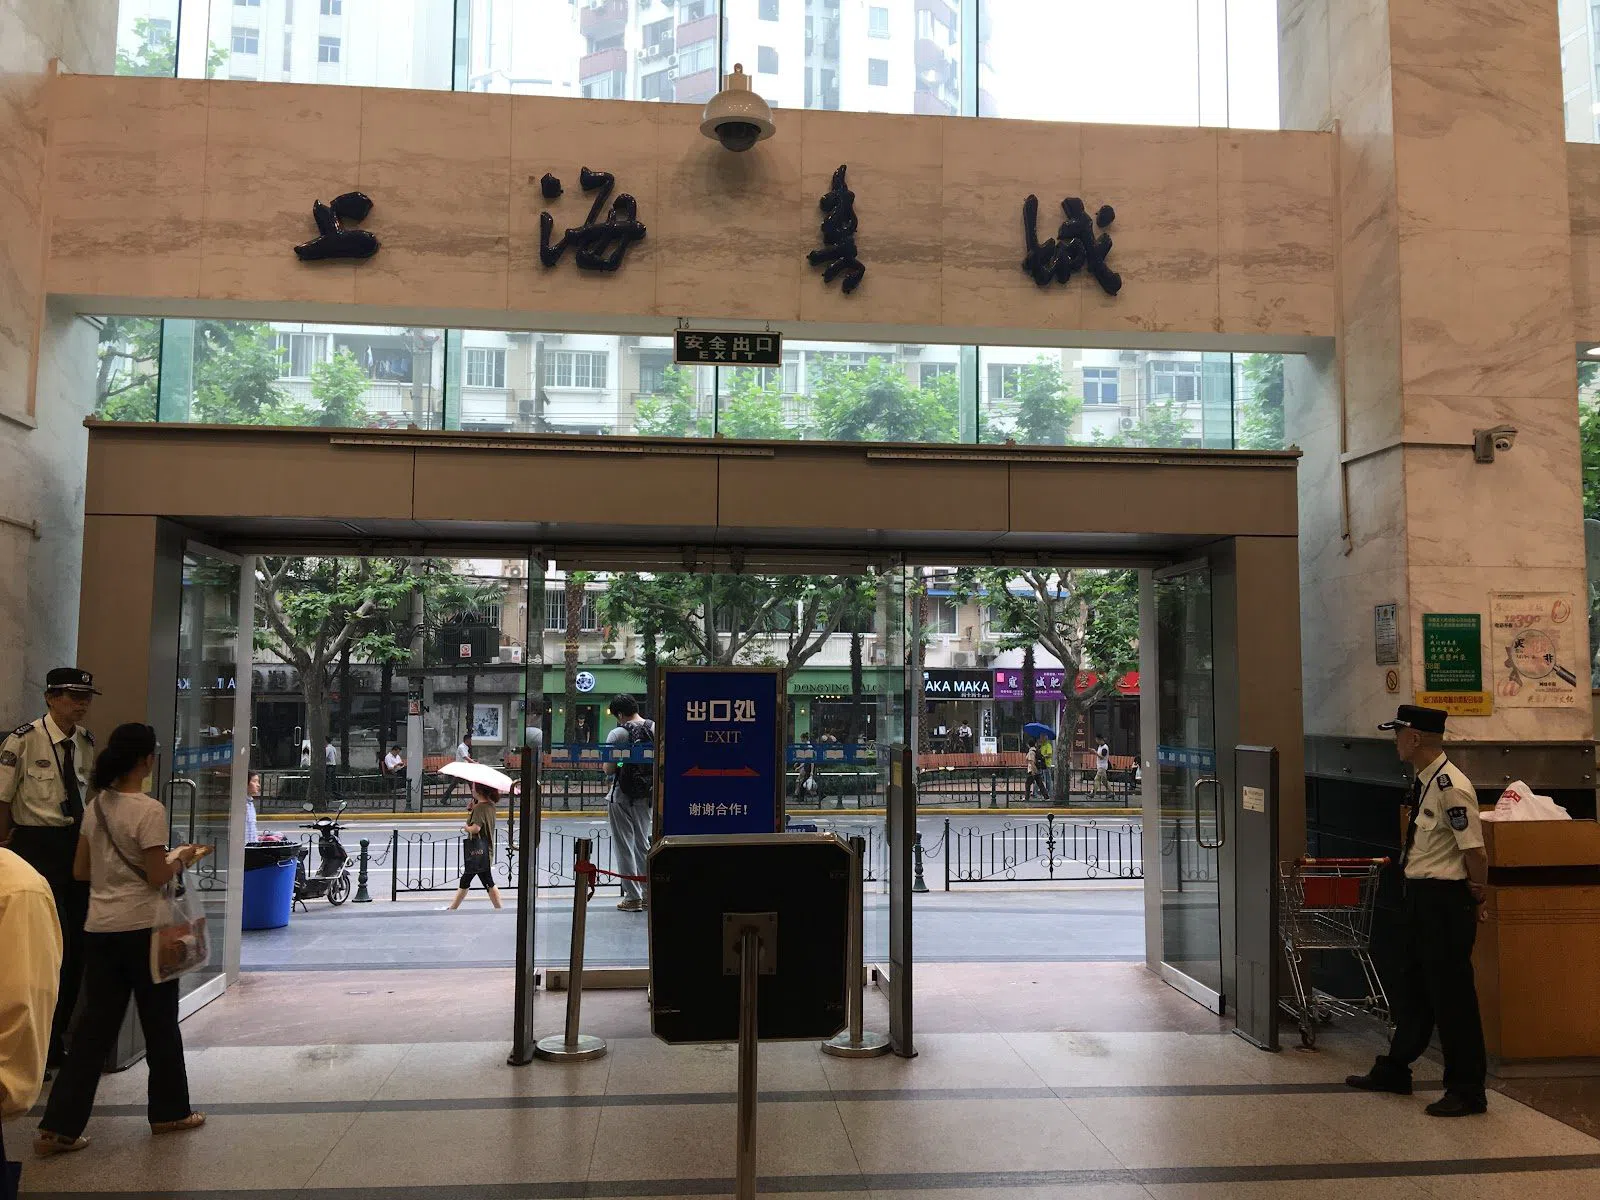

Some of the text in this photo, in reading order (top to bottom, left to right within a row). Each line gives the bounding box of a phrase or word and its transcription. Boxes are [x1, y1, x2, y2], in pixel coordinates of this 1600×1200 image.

[684, 335, 773, 352] 安全出口
[698, 351, 756, 360] EXIT
[794, 684, 849, 692] DONGYING
[925, 680, 990, 692] AKA MAKA
[686, 699, 756, 722] 出口处
[704, 730, 742, 743] EXIT
[688, 803, 748, 816] 谢谢合作!
